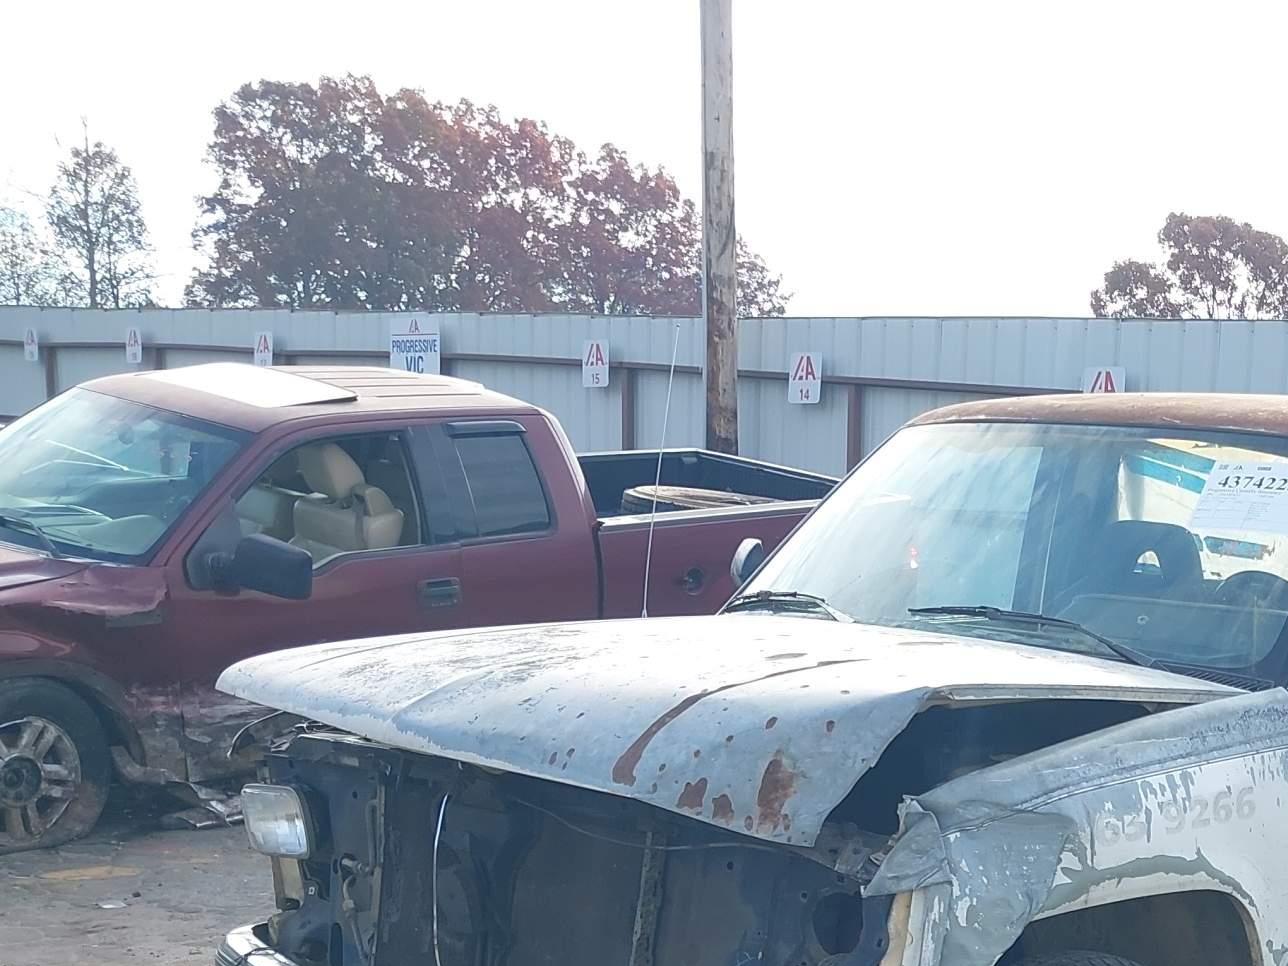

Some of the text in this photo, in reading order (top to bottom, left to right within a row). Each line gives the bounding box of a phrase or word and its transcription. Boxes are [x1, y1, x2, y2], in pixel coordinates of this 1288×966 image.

[391, 339, 438, 353] PROGRESSIVE
[405, 355, 424, 374] VIC
[591, 373, 600, 385] 15
[799, 388, 810, 401] 14
